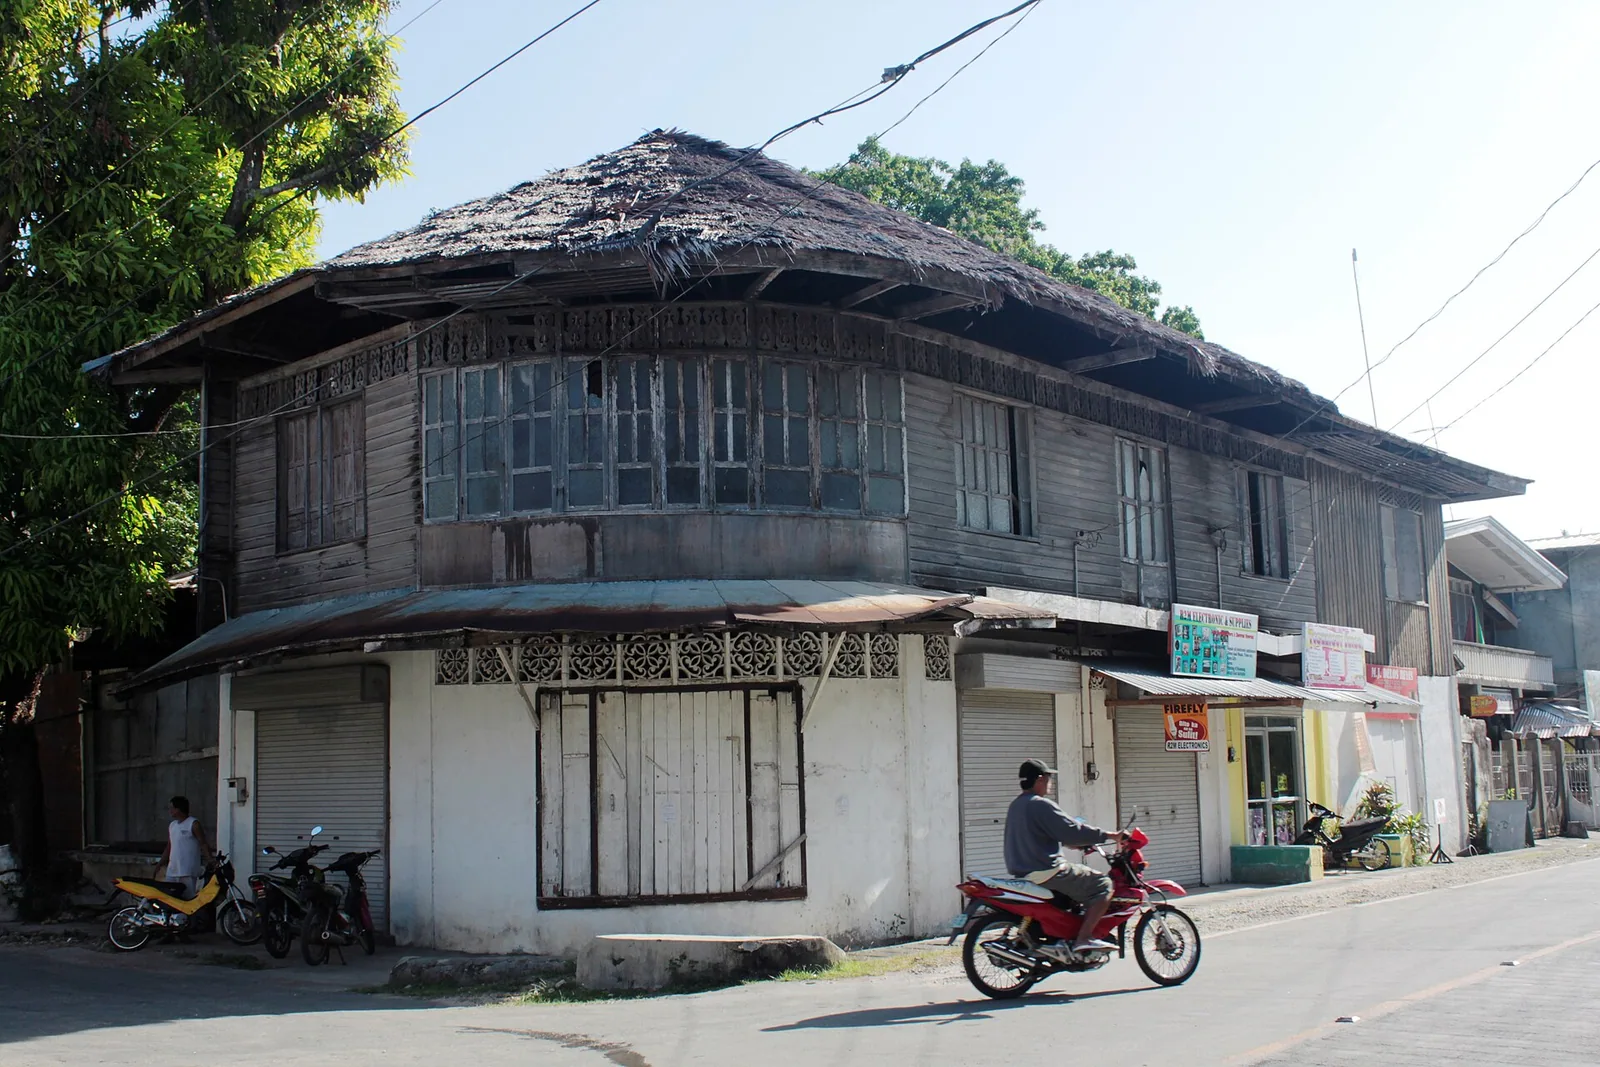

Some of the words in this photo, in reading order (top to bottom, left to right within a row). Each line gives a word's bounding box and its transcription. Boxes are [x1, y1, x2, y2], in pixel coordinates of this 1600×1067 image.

[1192, 611, 1224, 626] ELECTRONIC
[1229, 616, 1252, 629] SUPPLIES
[1164, 703, 1204, 713] FIREFLY
[1177, 741, 1208, 749] ELECTRONICS
